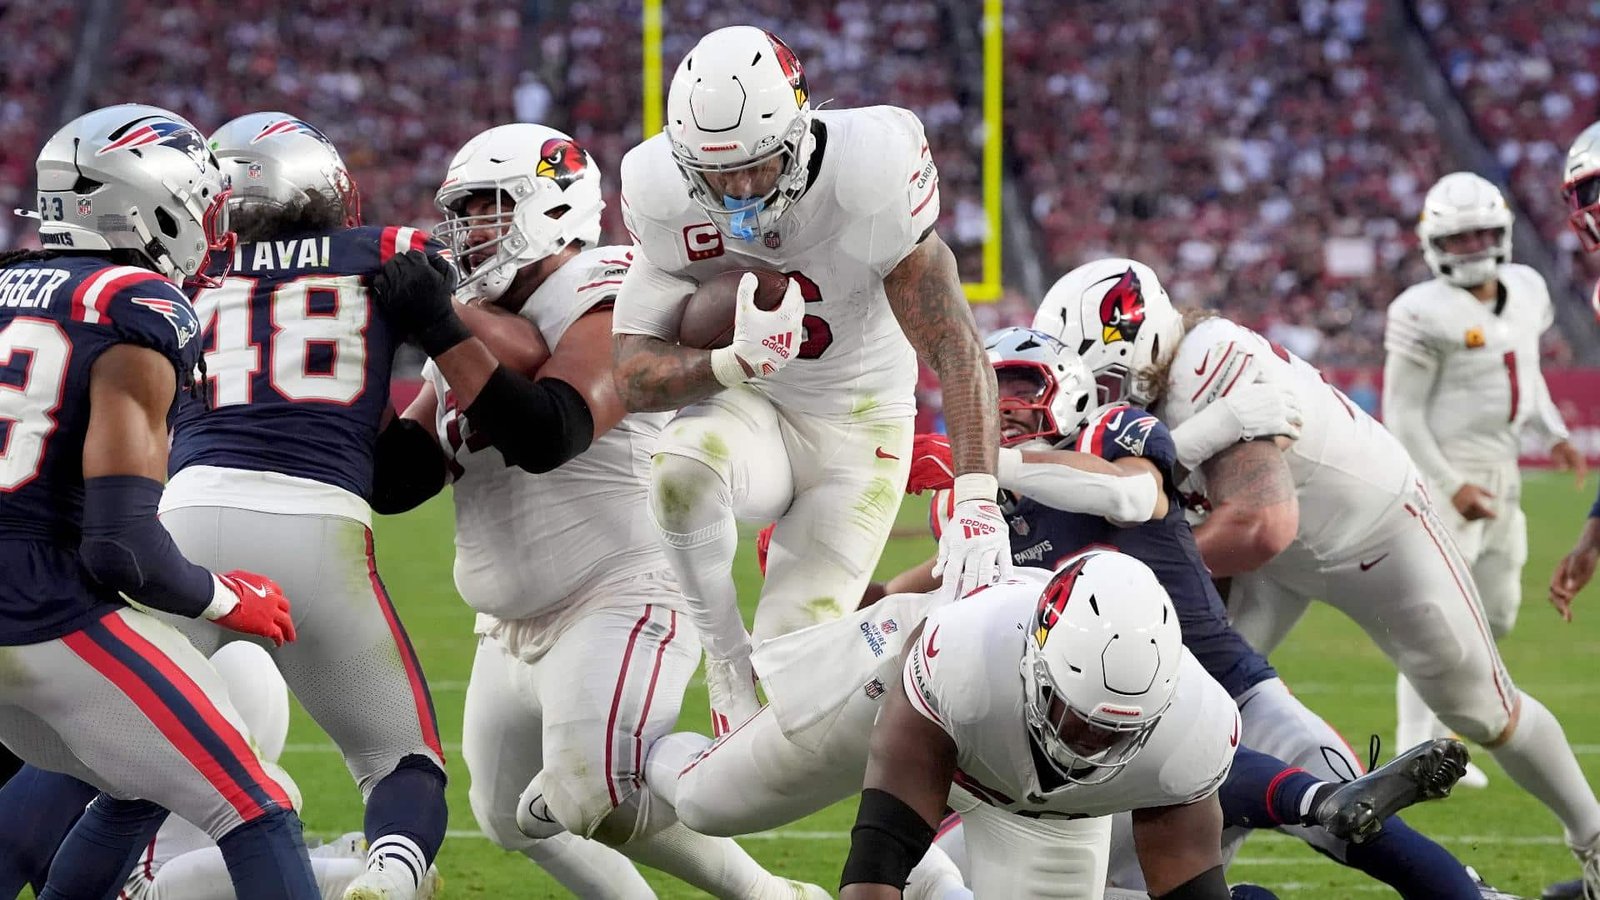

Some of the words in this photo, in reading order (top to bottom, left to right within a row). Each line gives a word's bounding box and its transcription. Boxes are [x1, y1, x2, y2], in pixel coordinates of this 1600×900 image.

[40, 197, 64, 221] 23
[687, 225, 719, 252] C
[191, 274, 371, 408] 48
[761, 338, 790, 359] adidas
[1503, 351, 1520, 422] 1
[959, 518, 996, 533] adidas
